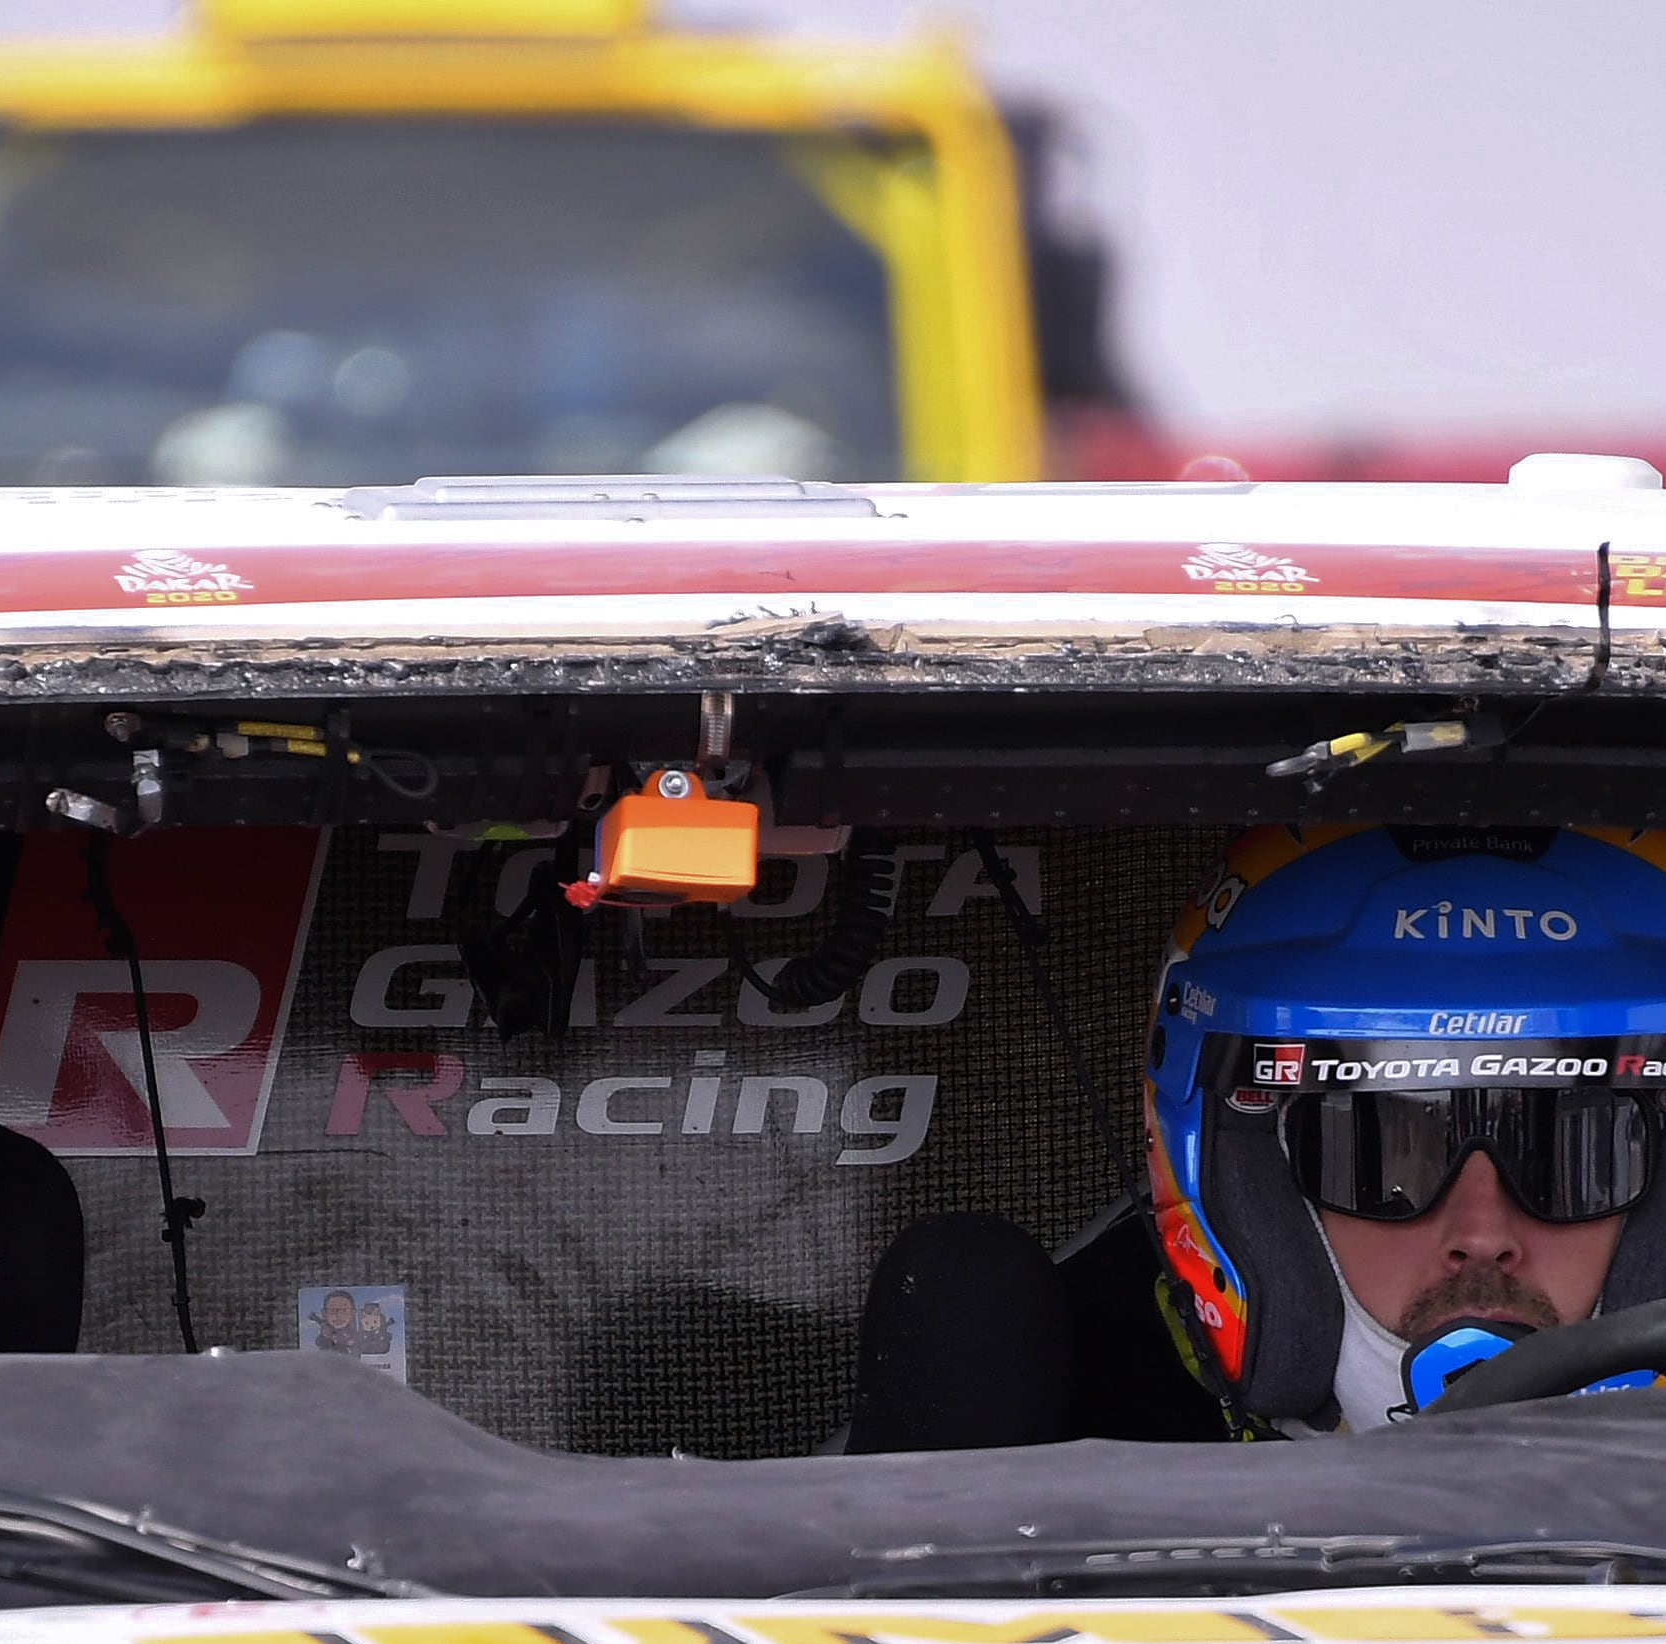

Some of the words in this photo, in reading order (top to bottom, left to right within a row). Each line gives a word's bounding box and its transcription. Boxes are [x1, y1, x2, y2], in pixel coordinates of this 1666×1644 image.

[146, 591, 238, 603] 2020
[1213, 581, 1305, 593] 2020
[1428, 1010, 1528, 1038] Cetilar
[1253, 1059, 1301, 1084] GR
[1311, 1057, 1461, 1082] TOYOTA
[1469, 1053, 1609, 1078] GAZOO
[323, 1049, 941, 1167] Racing
